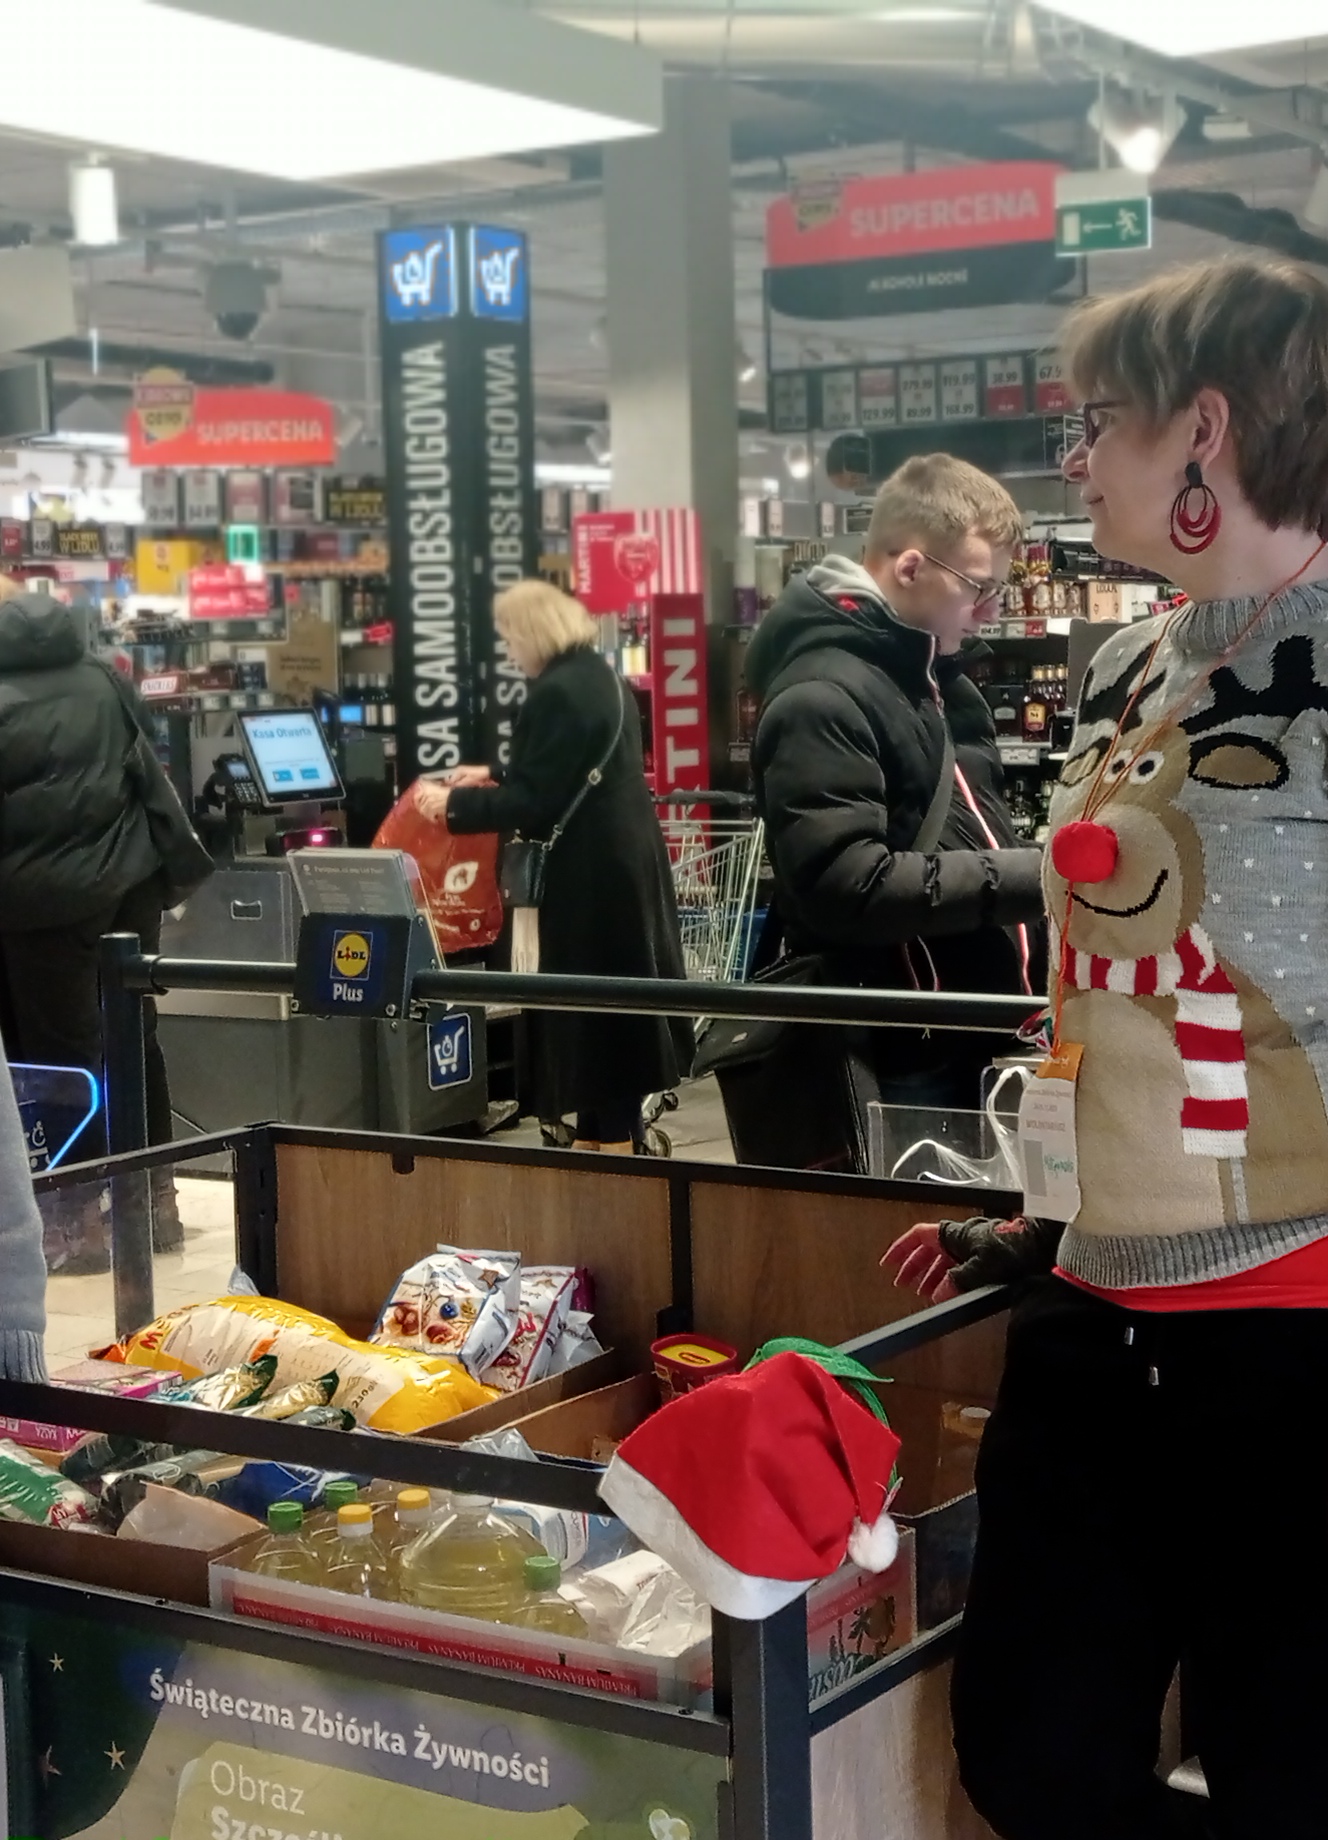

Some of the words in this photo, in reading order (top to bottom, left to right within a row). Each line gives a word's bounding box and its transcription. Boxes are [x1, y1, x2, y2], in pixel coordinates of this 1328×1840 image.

[851, 188, 1040, 238] SUPERCENA
[198, 419, 323, 446] SUPERCENA
[401, 341, 459, 708] SAMOOBSŁUGOWA
[484, 344, 528, 708] SAOBSŁUGOWA
[416, 717, 461, 784] ASA
[337, 946, 366, 961] LIDL
[333, 983, 364, 1003] Plus
[150, 1668, 296, 1731] Świąteczna
[301, 1704, 407, 1757] Zbiórka
[413, 1723, 550, 1789] Żywności
[210, 1759, 306, 1816] Obraz
